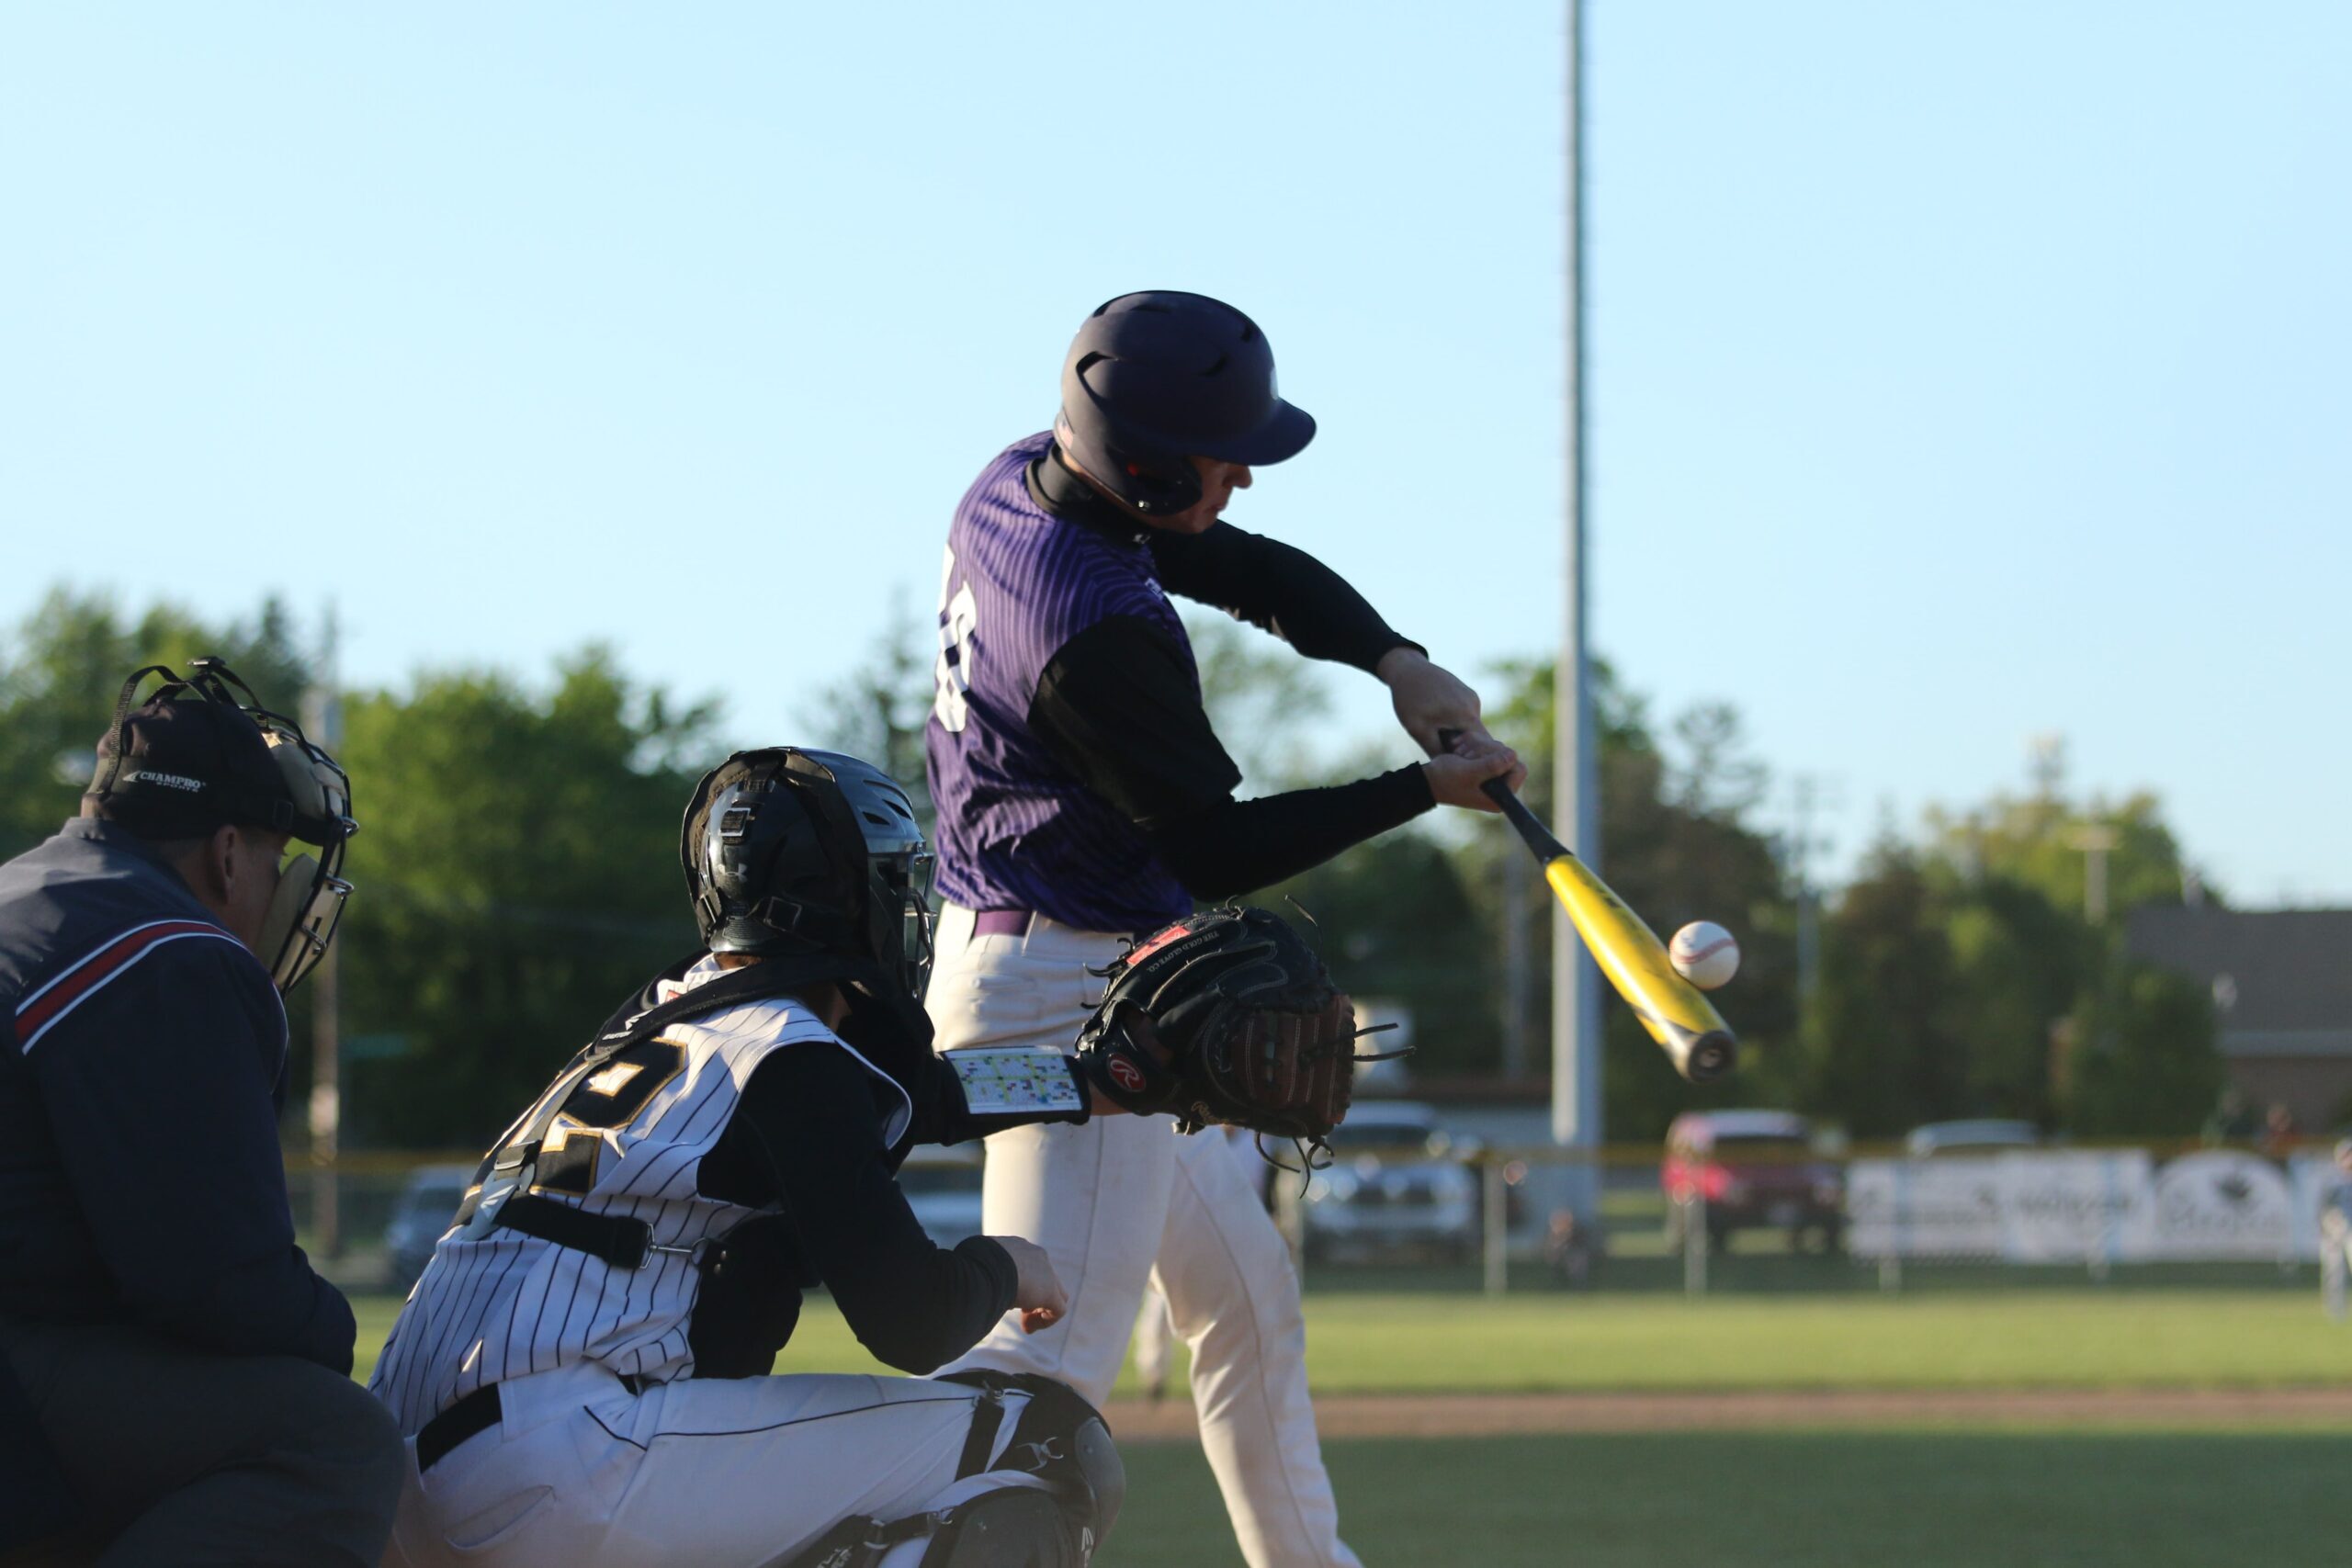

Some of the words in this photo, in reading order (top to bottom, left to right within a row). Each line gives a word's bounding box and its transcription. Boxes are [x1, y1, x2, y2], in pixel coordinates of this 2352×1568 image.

[140, 772, 201, 789] CHAMPRO
[1182, 937, 1204, 952] GOLD
[1204, 931, 1220, 942] THE
[1158, 947, 1182, 964] GLOVE
